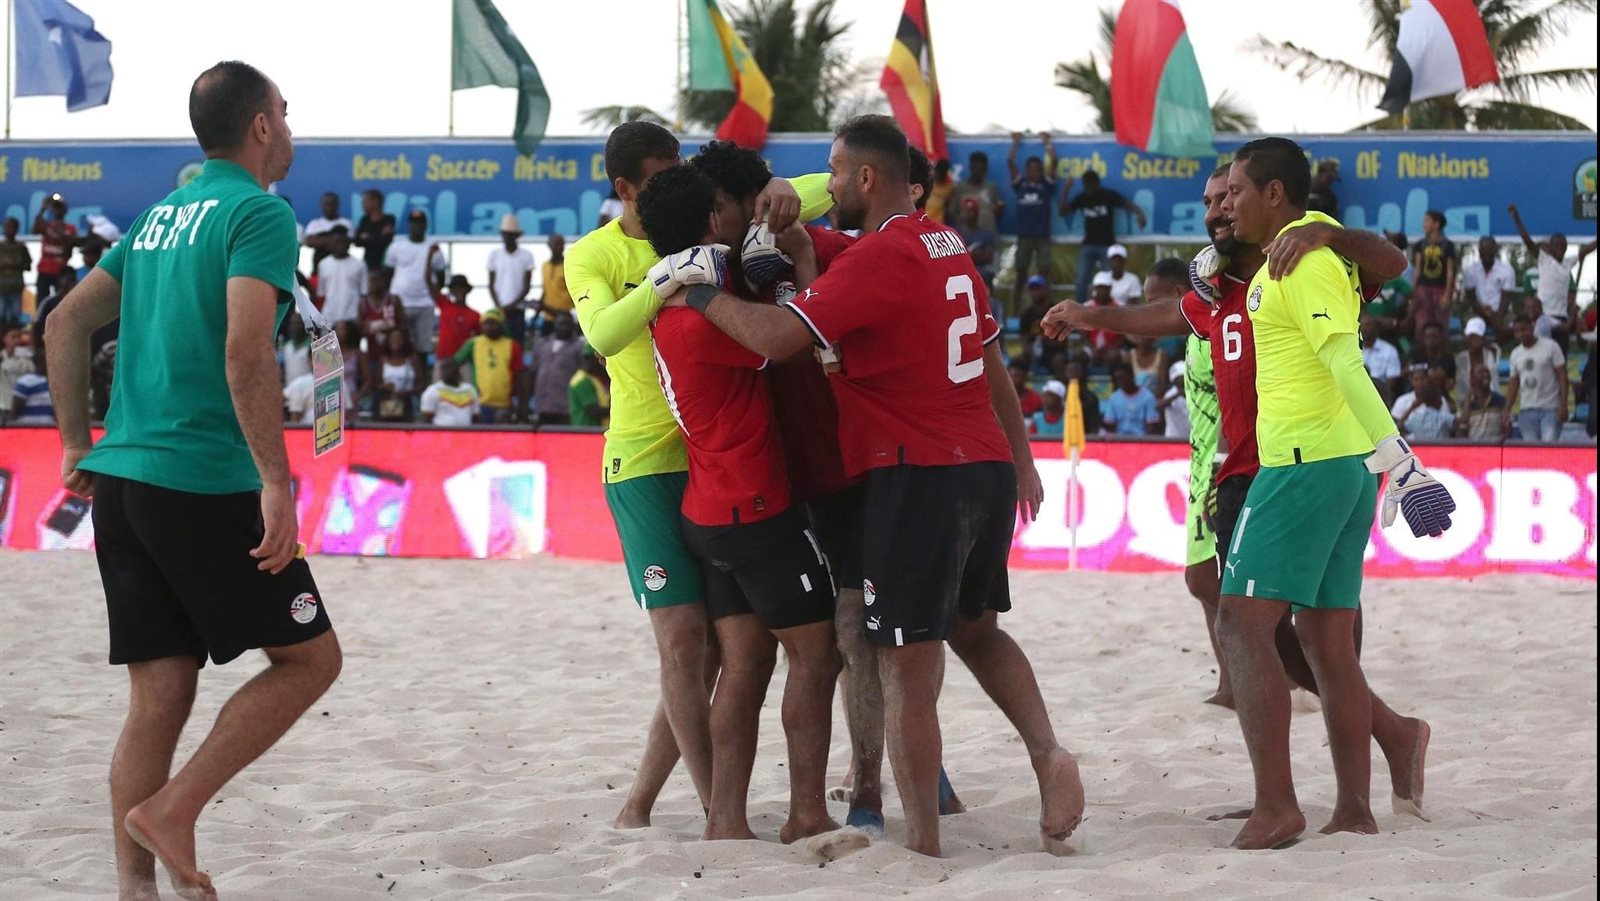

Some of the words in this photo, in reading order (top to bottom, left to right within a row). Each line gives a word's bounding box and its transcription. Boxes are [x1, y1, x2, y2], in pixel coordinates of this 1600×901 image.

[23, 156, 102, 182] Nations
[353, 153, 412, 180] Beach
[426, 154, 499, 181] Soccer
[1044, 152, 1107, 178] each
[1122, 152, 1200, 180] Soccer
[1398, 151, 1489, 179] Nations
[133, 199, 219, 250] EGYPT
[945, 274, 984, 384] 2
[1222, 313, 1242, 361] 6
[1195, 514, 1205, 542] 1
